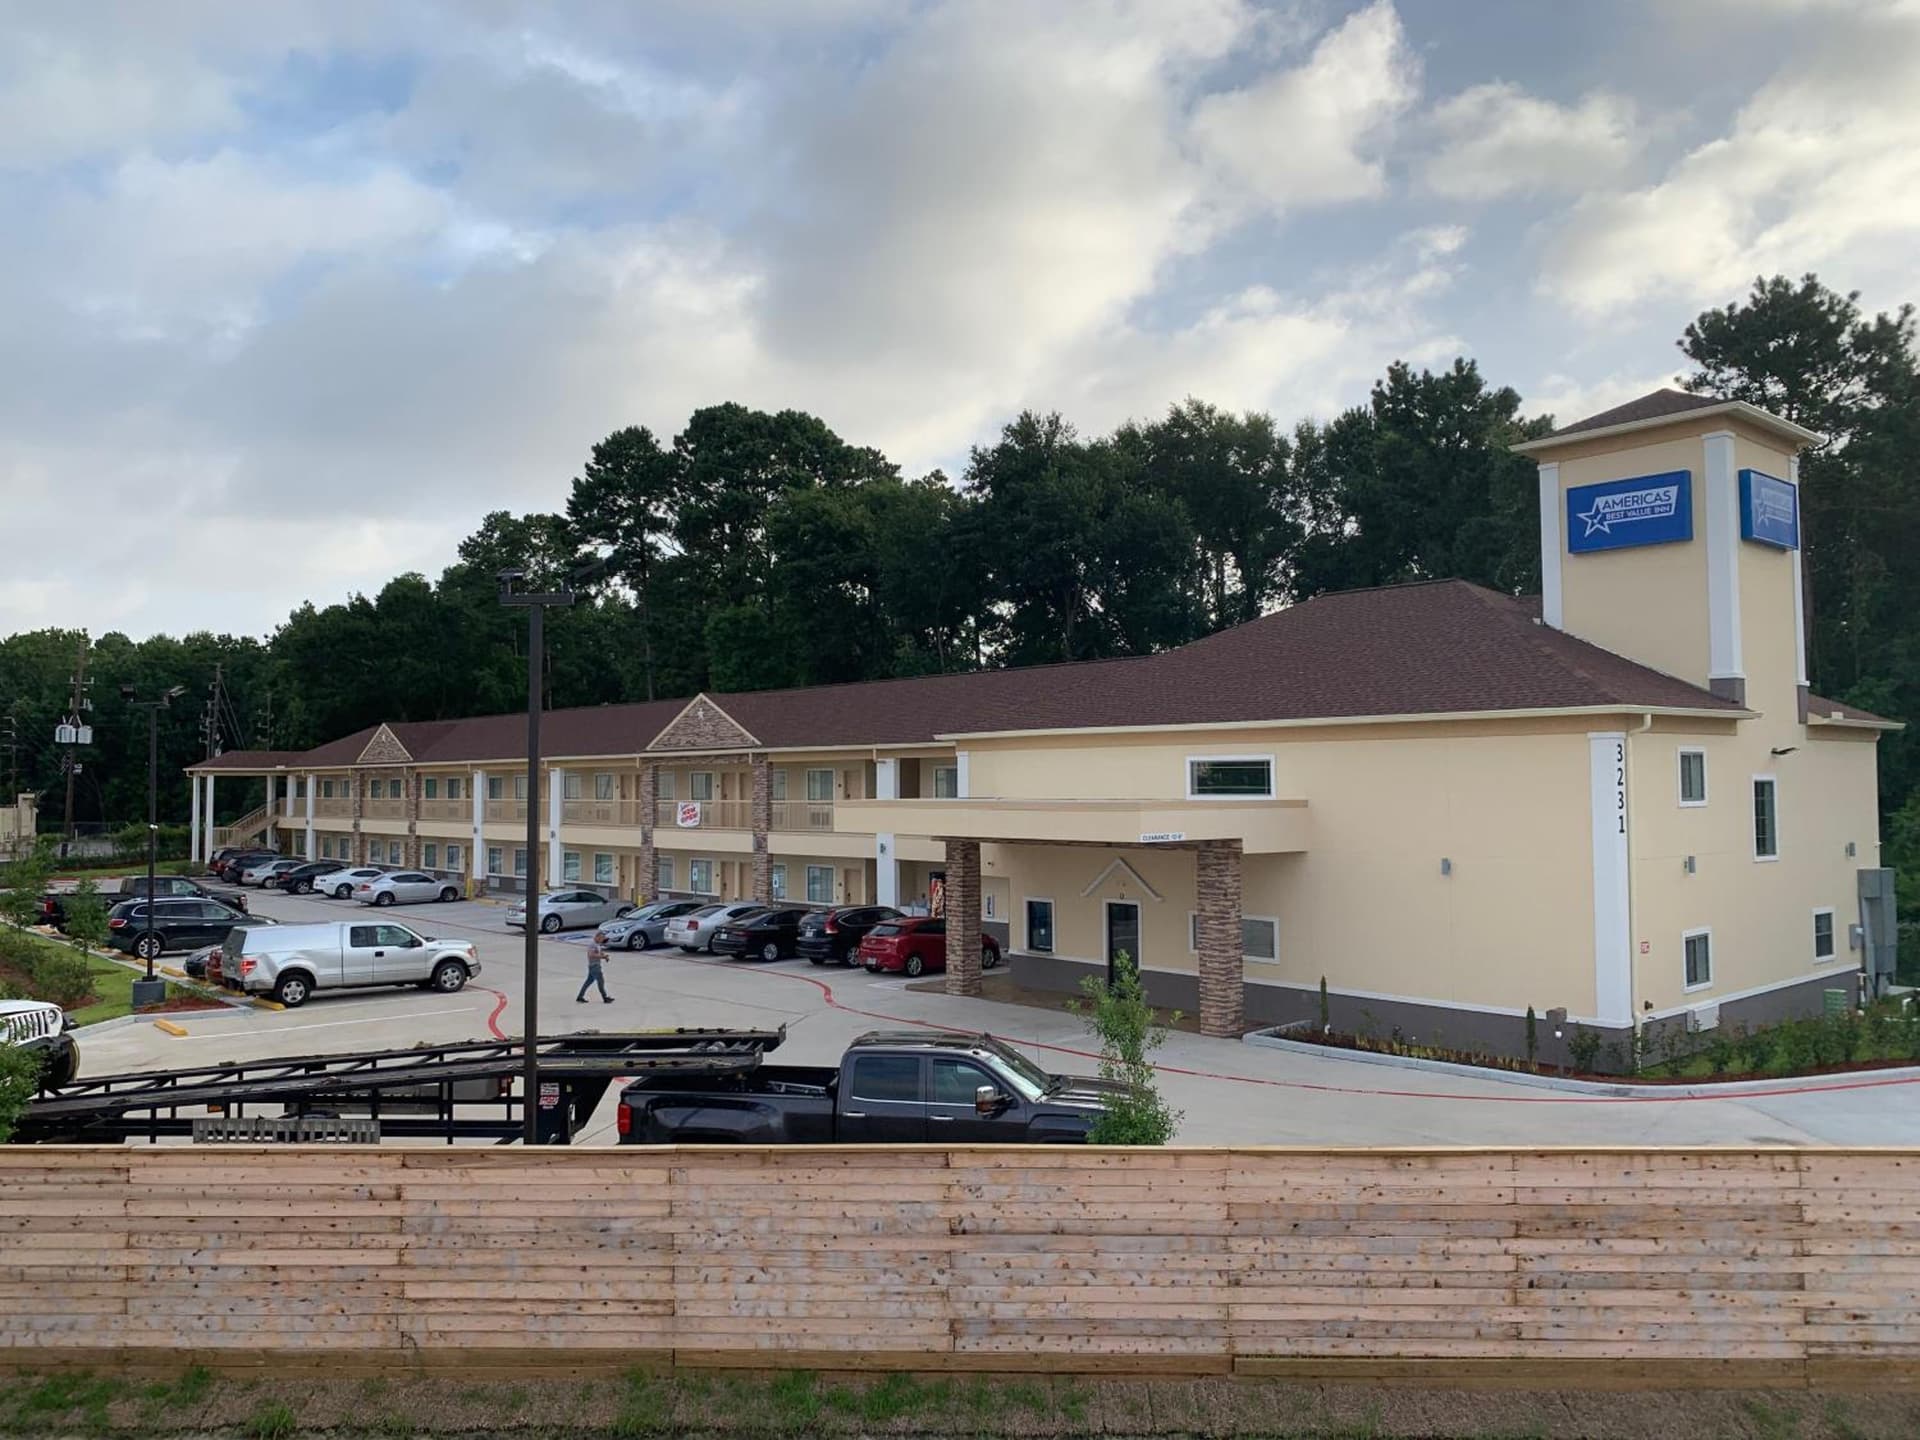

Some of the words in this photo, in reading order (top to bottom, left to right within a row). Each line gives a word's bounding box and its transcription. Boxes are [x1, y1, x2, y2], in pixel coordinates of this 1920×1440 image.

[1602, 490, 1671, 510] AMERICAS
[1605, 511, 1624, 520] BEST
[1627, 508, 1651, 517] VALUE
[1654, 505, 1671, 514] INN
[1617, 744, 1625, 833] 3231
